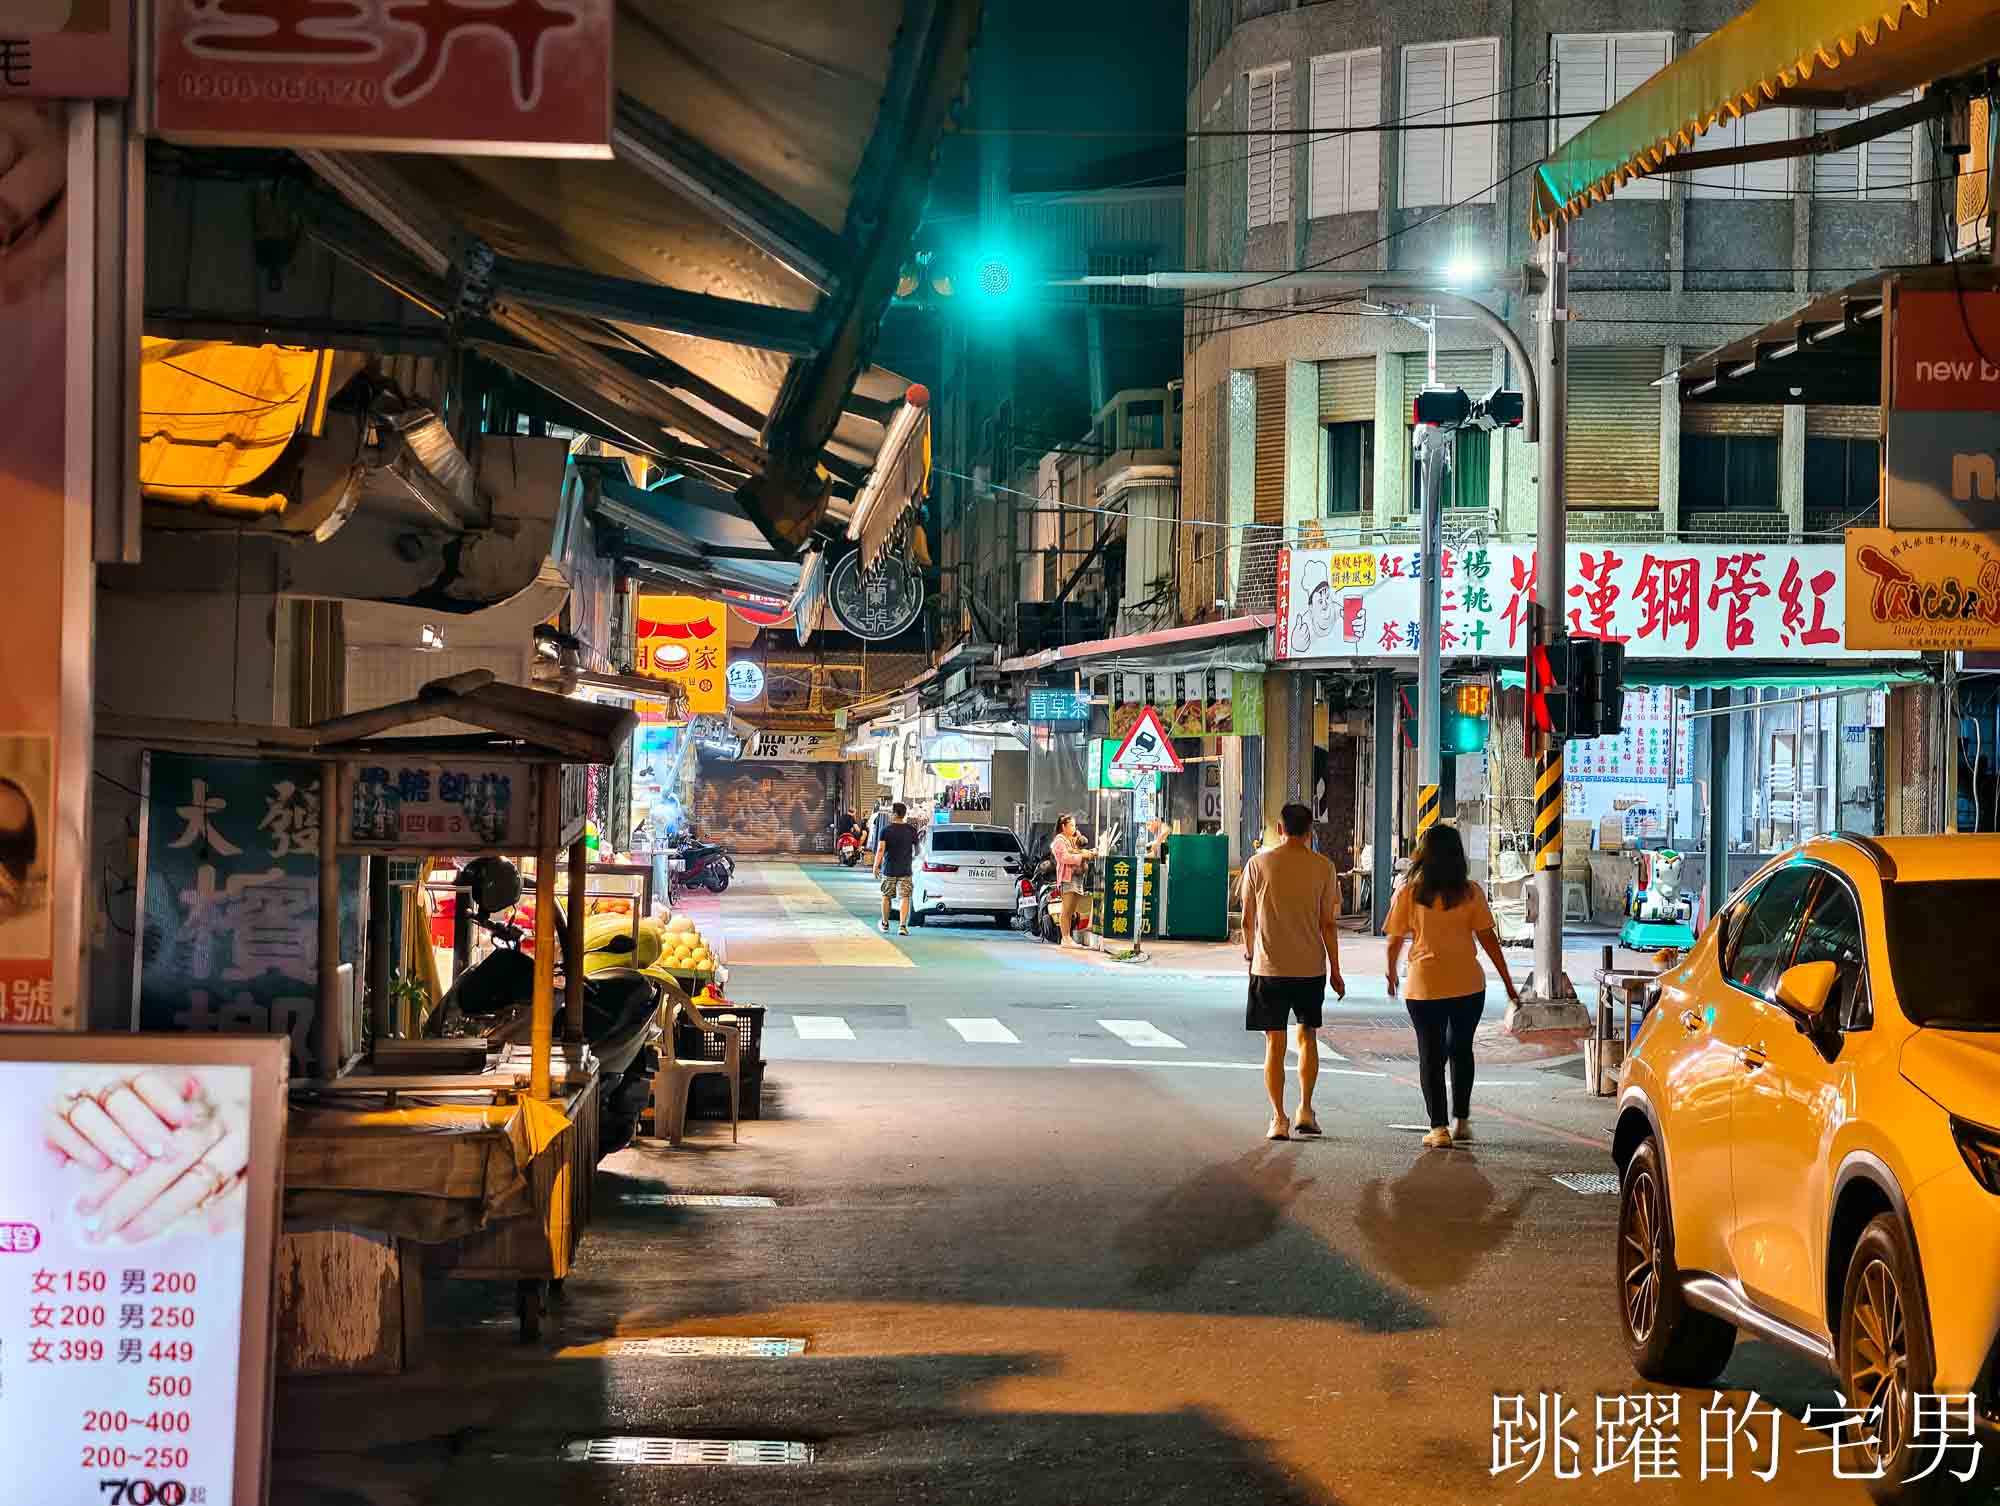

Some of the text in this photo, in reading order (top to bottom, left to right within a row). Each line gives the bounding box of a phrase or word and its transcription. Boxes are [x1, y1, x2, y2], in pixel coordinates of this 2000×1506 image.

[1916, 361, 1973, 382] new
[1462, 551, 1493, 650] 楊桃汁
[1032, 692, 1088, 720] 青草茶
[1113, 861, 1131, 934] 金桔檸檬
[32, 1268, 197, 1294] 女150 男200
[30, 1303, 195, 1329] 女200 男250
[28, 1337, 193, 1364] 女399 男449
[147, 1376, 192, 1397] 500
[82, 1410, 191, 1432] 200~400
[81, 1446, 189, 1468] 200~250
